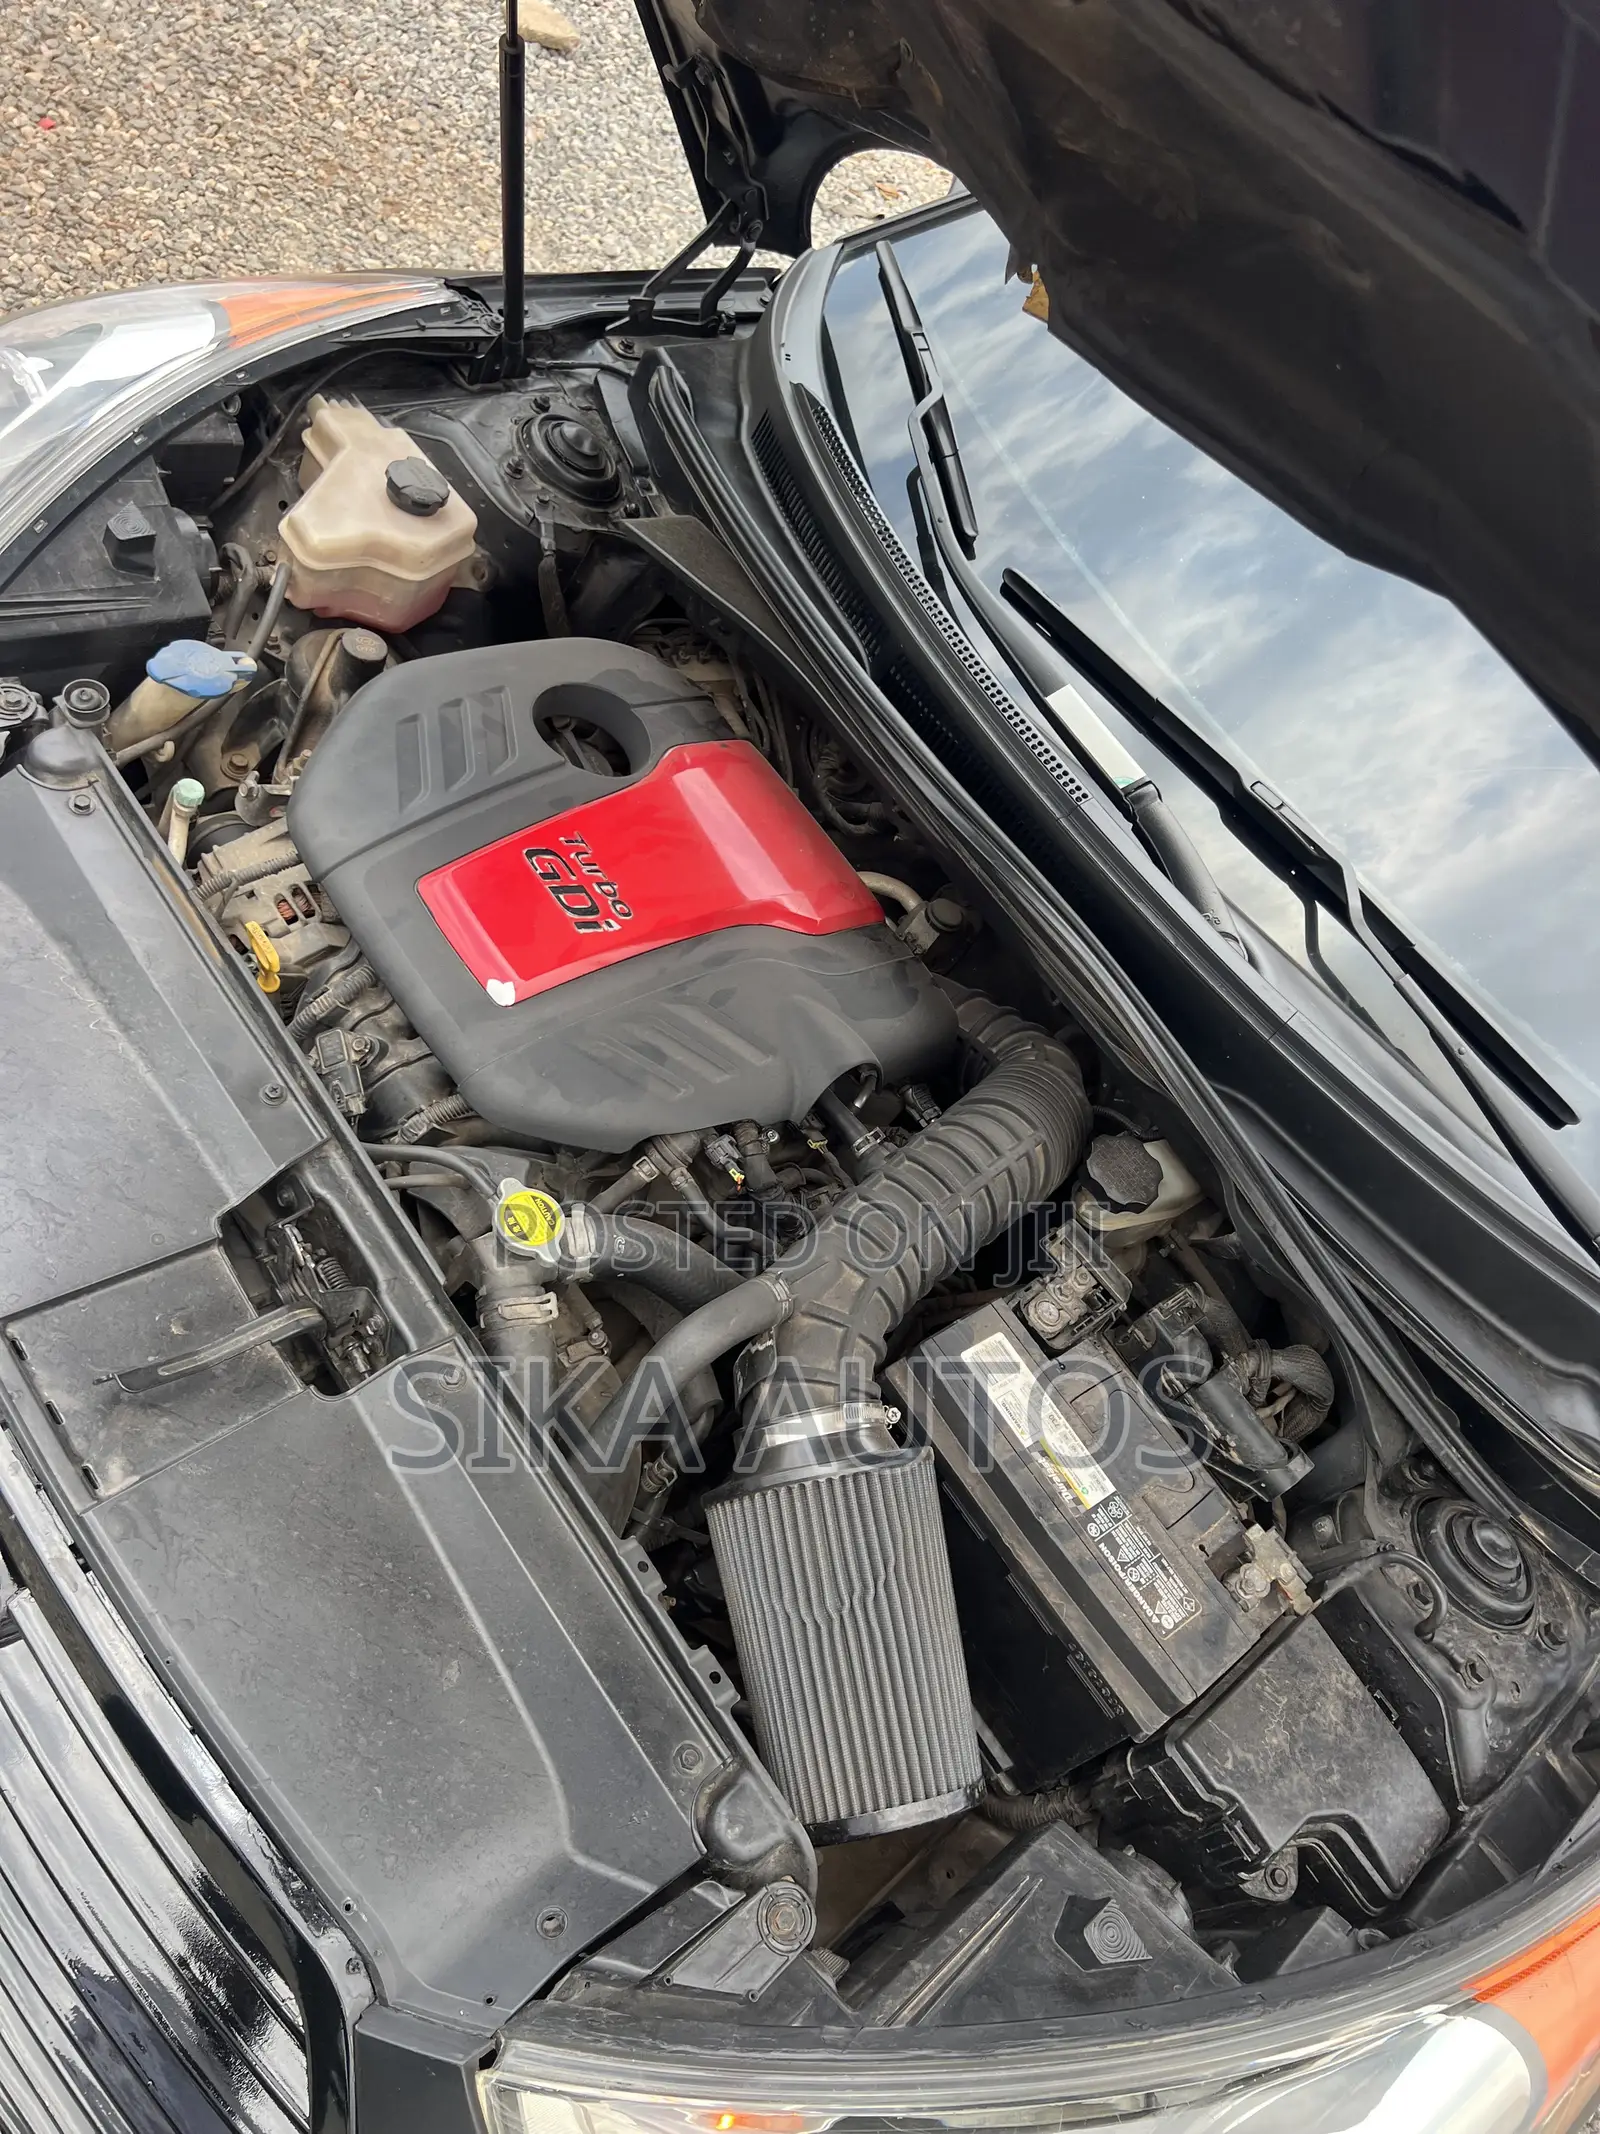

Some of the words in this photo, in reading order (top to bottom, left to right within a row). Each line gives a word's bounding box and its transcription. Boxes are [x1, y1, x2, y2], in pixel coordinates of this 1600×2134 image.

[522, 847, 622, 934] GDi
[533, 1197, 556, 1226] CAUTION
[1047, 1413, 1060, 1428] 730
[1036, 1455, 1074, 1504] Duralast
[1097, 1541, 1155, 1617] DANGER/POISON
